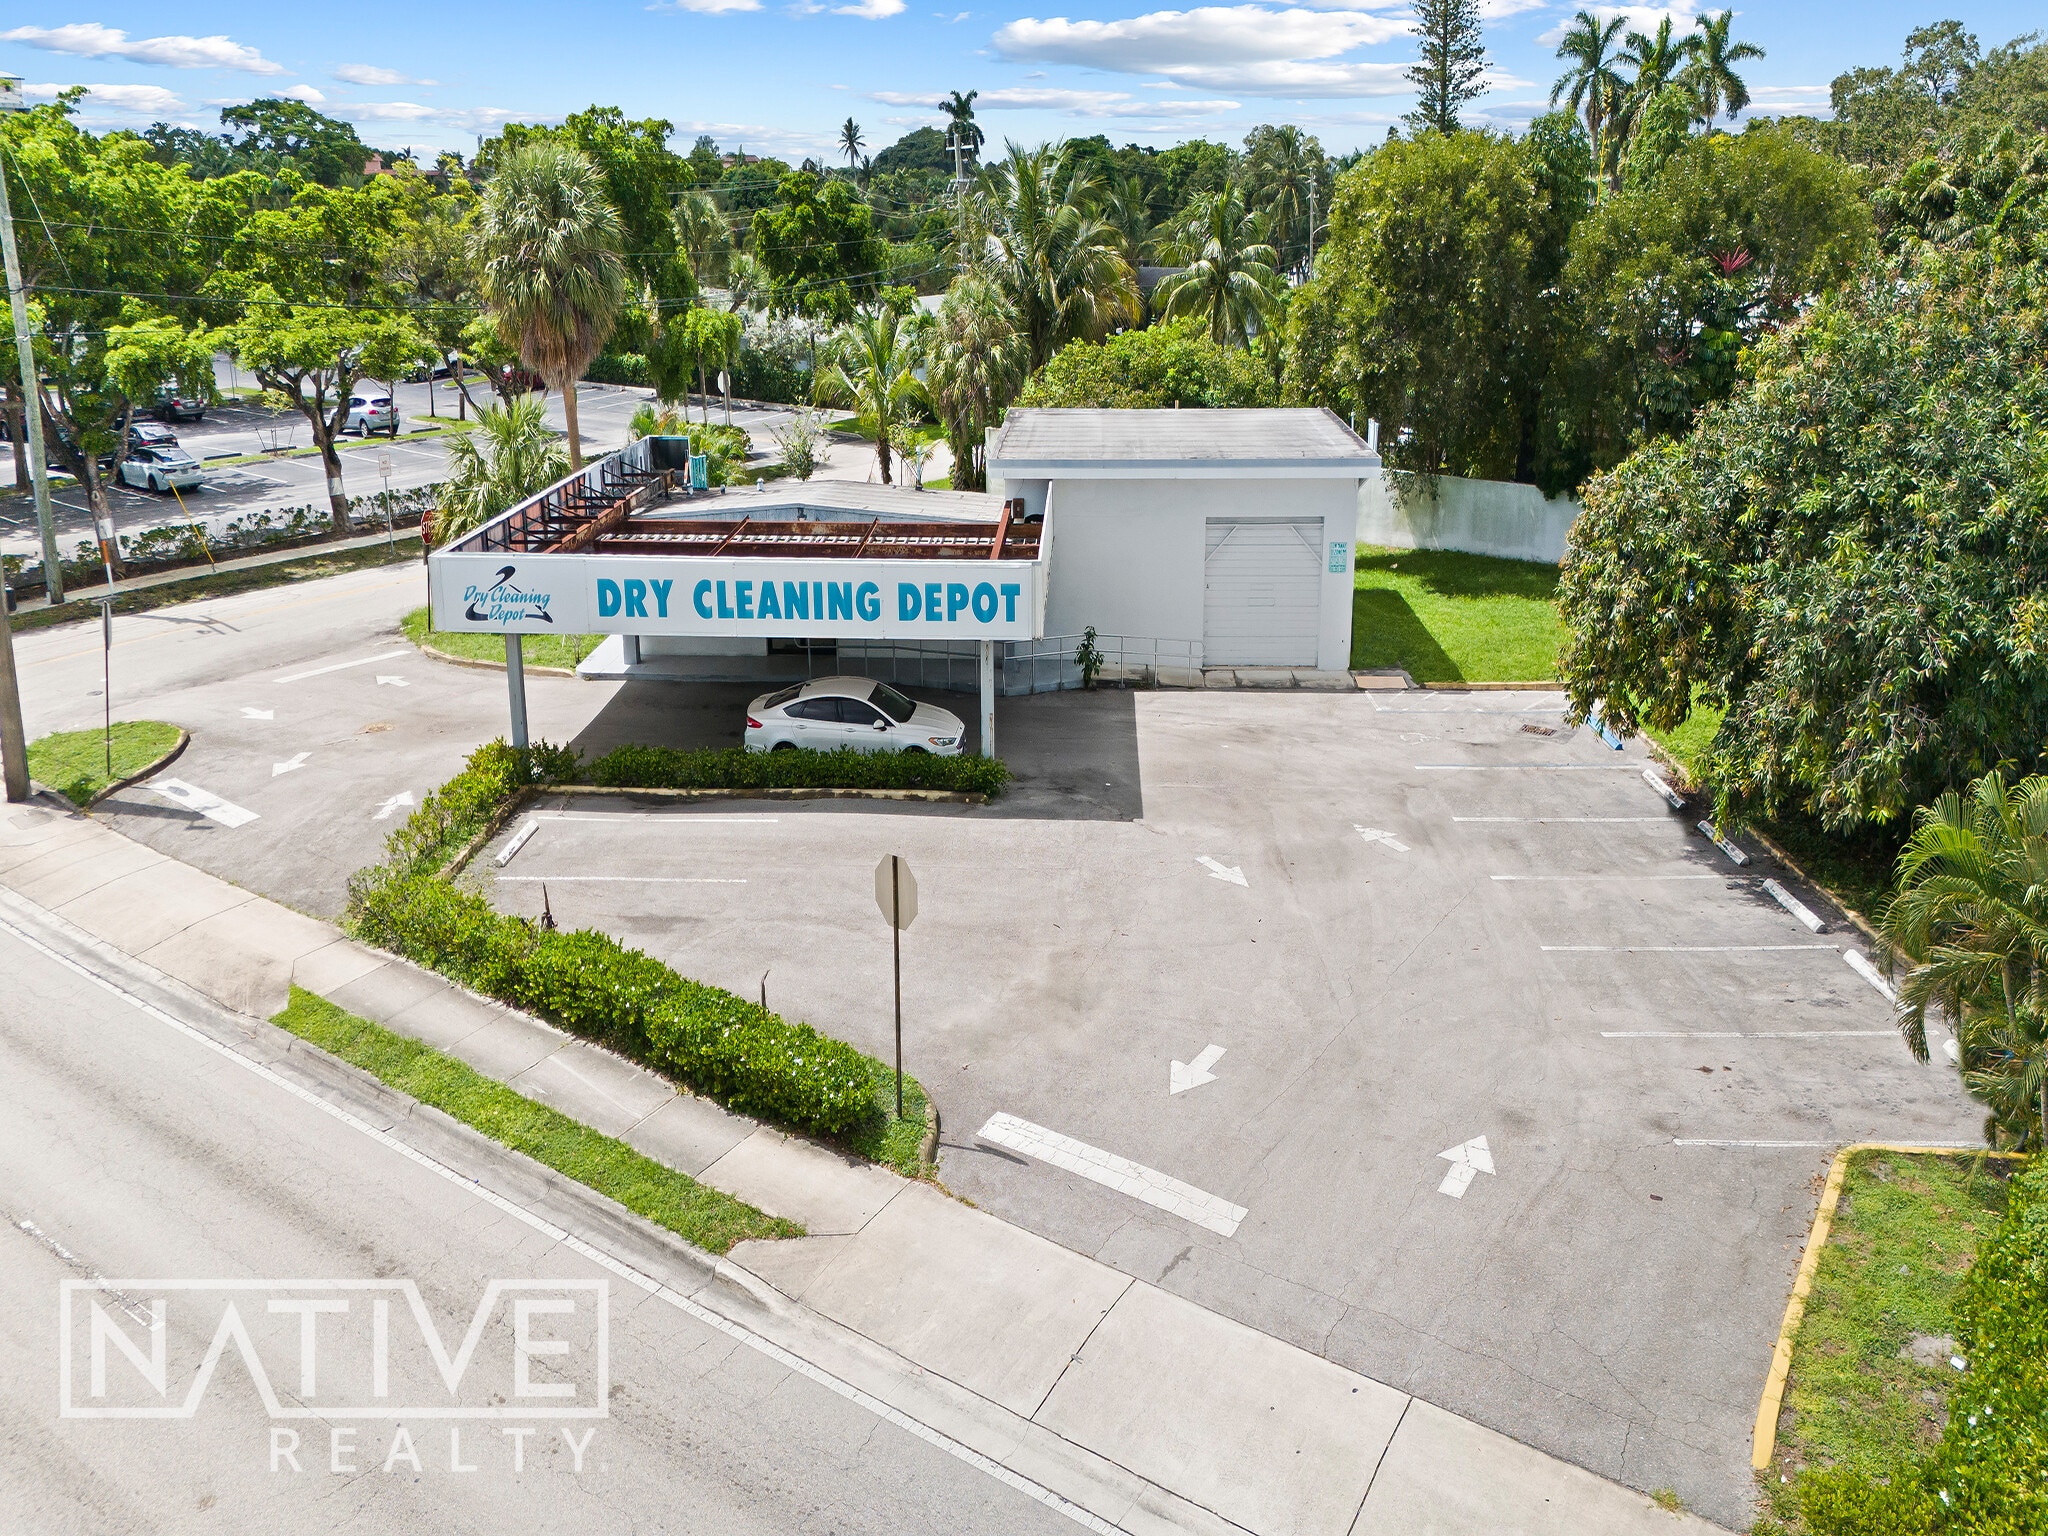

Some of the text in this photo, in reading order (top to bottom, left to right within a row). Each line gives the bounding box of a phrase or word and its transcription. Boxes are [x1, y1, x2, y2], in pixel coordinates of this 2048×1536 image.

[464, 585, 551, 610] Dry Cleaning
[596, 578, 1021, 623] DRY CLEANING DEPOT
[488, 603, 525, 626] Depot
